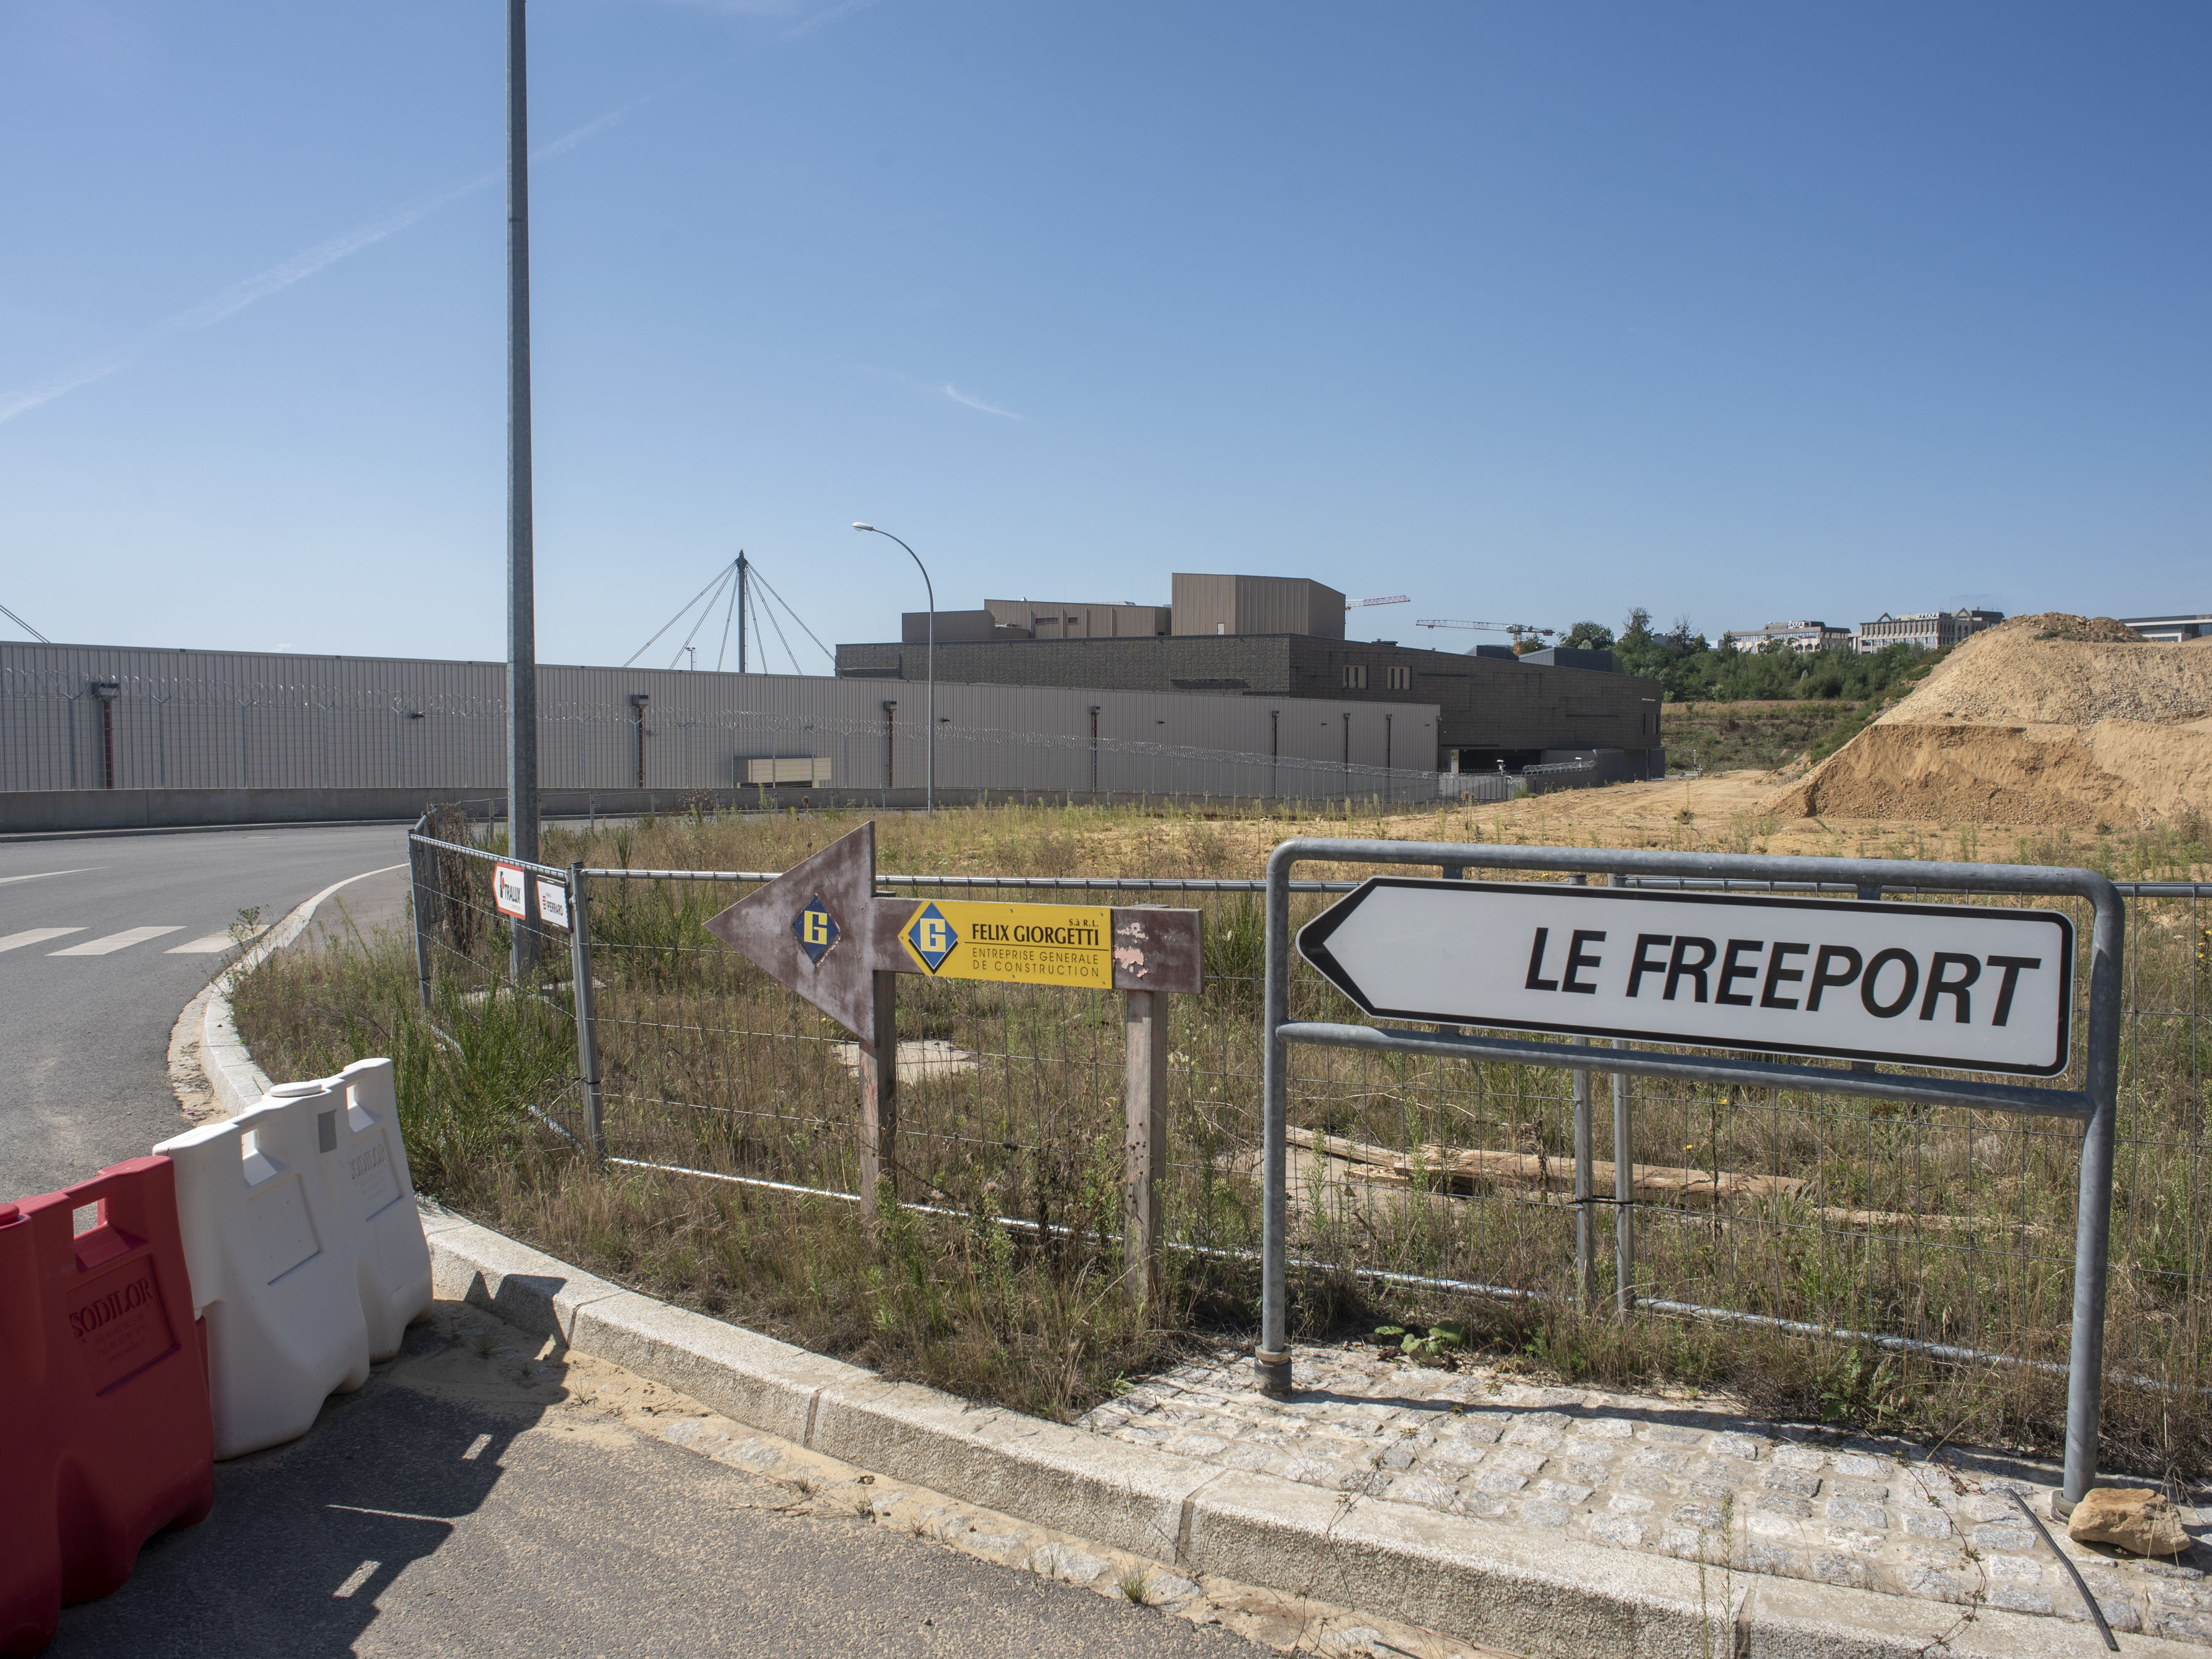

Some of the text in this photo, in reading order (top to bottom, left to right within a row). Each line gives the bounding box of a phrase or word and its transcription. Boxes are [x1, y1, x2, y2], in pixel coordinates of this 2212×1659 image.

[505, 884, 521, 904] TRALUX
[803, 910, 828, 944] G
[920, 918, 946, 953] G
[972, 923, 1099, 946] FELIX GIORGETTI
[972, 948, 1099, 964] ENTREPRISE GENERALE
[972, 959, 1099, 977] DE CONSTRUCTION
[1525, 927, 2042, 1027] LE FREEPORT
[68, 1277, 155, 1340] SODILOR
